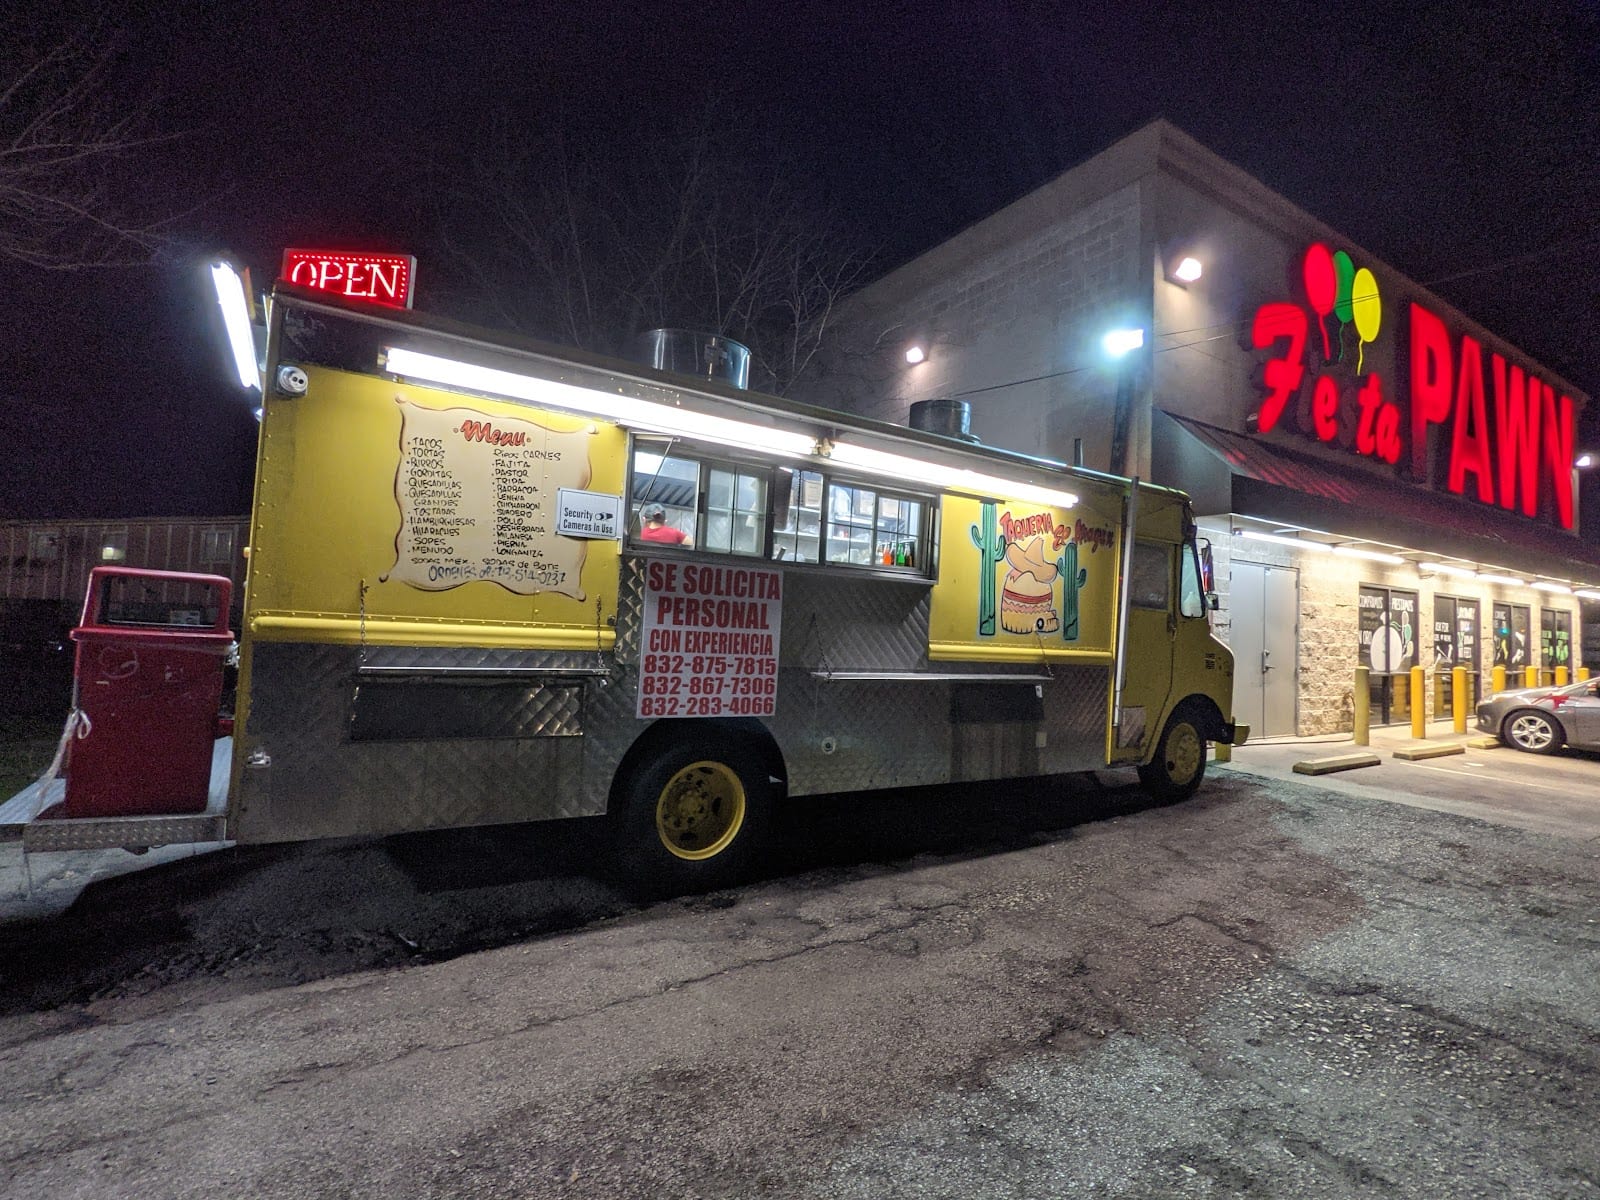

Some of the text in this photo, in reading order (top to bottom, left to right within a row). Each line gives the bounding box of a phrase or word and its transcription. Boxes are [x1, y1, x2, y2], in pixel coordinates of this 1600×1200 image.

[291, 260, 400, 298] OPEN
[1410, 302, 1574, 530] PAWN
[460, 420, 526, 447] Menu
[412, 437, 443, 449] TACOS
[412, 447, 445, 459] TORTAS
[522, 450, 561, 461] CARNES
[410, 457, 444, 469] BURROS
[495, 459, 531, 468] FAJITA
[410, 468, 452, 479] GORDITAS
[495, 468, 529, 477] PASTOR
[408, 477, 462, 489] QUESADILLAS
[495, 477, 525, 485] TRIPA
[408, 487, 462, 498] QUESADILLAS
[496, 484, 539, 494] BARBACOA
[413, 499, 459, 507] GRANDES
[413, 507, 456, 516] TOSTADAS
[564, 507, 593, 521] Security
[497, 517, 523, 526] POLLO
[563, 519, 592, 532] Cameras
[601, 524, 613, 534] Use
[414, 537, 446, 546] SOPES
[497, 540, 527, 548] PIERNA
[412, 546, 454, 555] MENUDO
[648, 561, 780, 600] SE SOLICITA
[656, 596, 769, 630] PERSONAL
[649, 629, 773, 655] CON EXPERIENCIA
[644, 654, 776, 675] 832-875-7815
[642, 676, 775, 695] 832-867-7306
[641, 696, 774, 716] 832-283-4066
